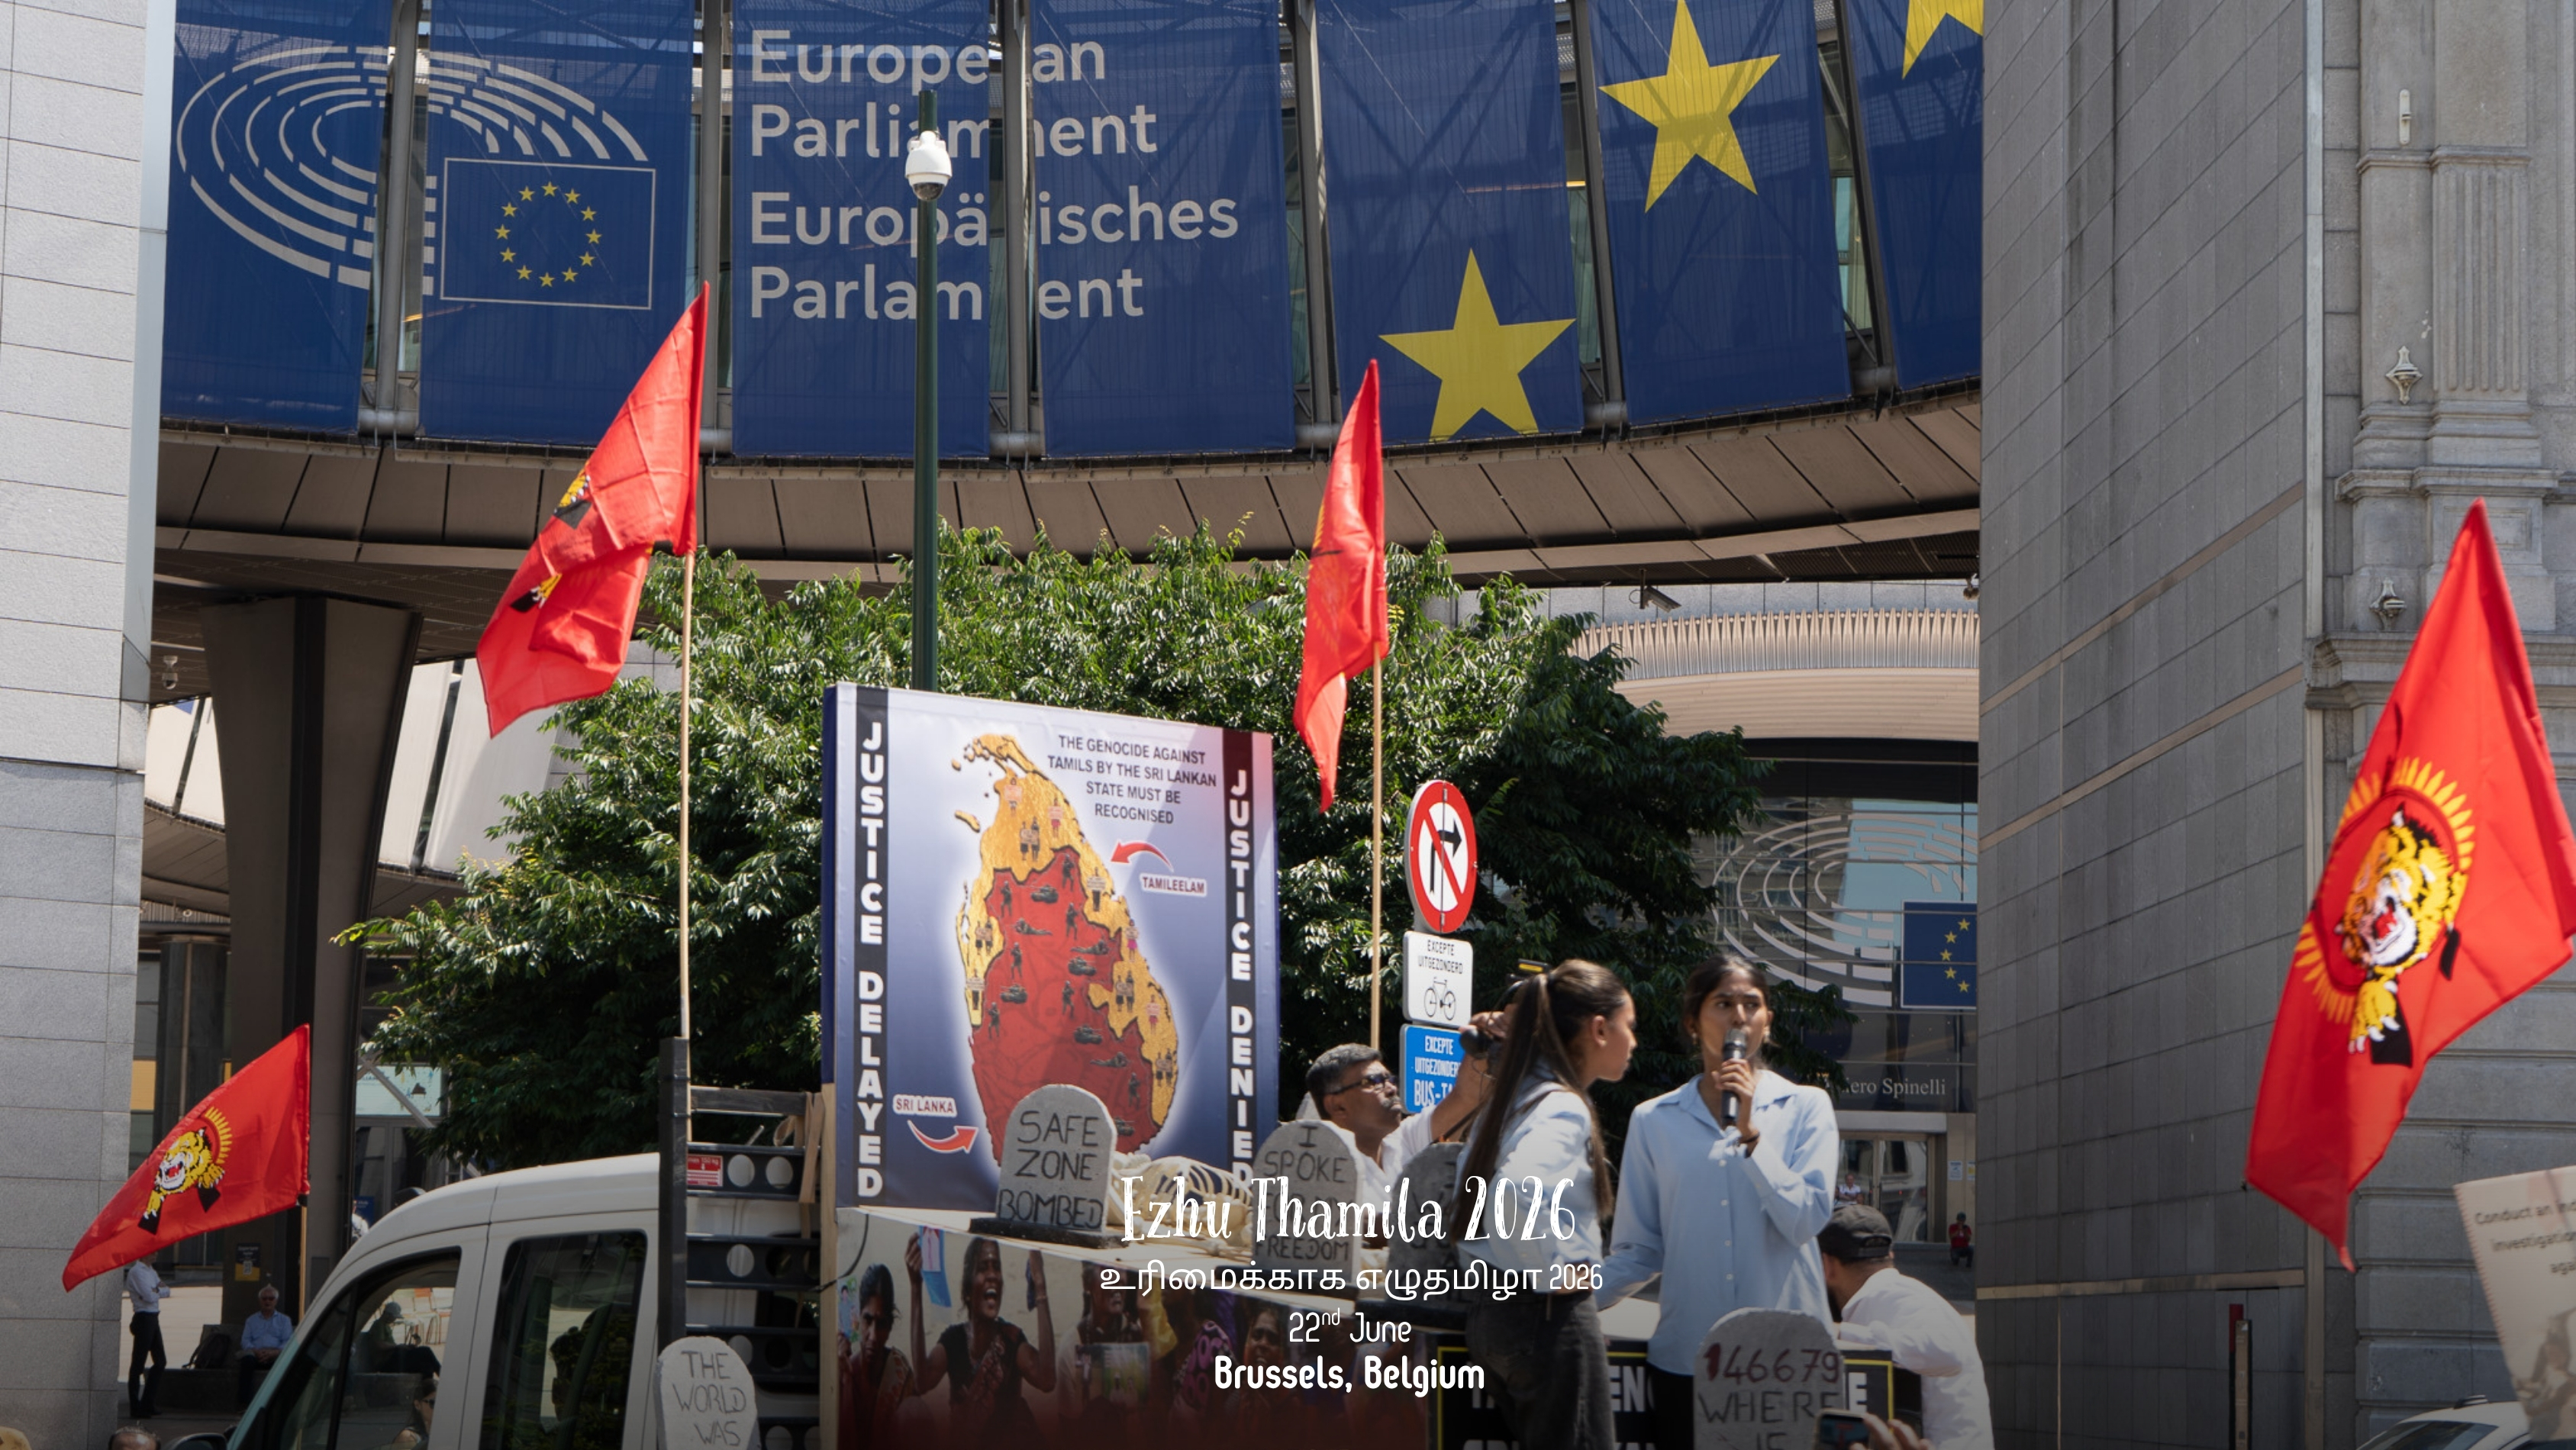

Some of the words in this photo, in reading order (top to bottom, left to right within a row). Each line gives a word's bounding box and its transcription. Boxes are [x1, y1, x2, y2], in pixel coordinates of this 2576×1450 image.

[751, 29, 1105, 96] European
[751, 102, 1158, 158] Parliment
[1059, 735, 1083, 750] THE
[1087, 738, 1149, 758] GENOCIDE
[1153, 746, 1205, 764] AGAINST
[1048, 755, 1092, 772] TAMILS
[1097, 761, 1112, 775] BY
[1117, 763, 1140, 778] THE
[1144, 767, 1164, 781] SRI
[1167, 769, 1217, 787] LANKAN
[1086, 781, 1124, 798] STATE
[1127, 785, 1161, 801] MUST
[1165, 790, 1181, 804] BE
[1095, 803, 1174, 824] RECOGNISED
[860, 722, 885, 945] JUSTICE
[1143, 876, 1204, 894] TAMILEELAM
[1230, 769, 1252, 981] JUSTICE
[1427, 939, 1455, 956] EXCEPTE
[1417, 955, 1463, 975] UITGEZONDERD
[1425, 1035, 1453, 1055] EXCEPTE
[1414, 1056, 1461, 1078] UITGEZONDER
[857, 971, 885, 1197] DELAYED
[1230, 1007, 1254, 1188] DENIED
[1882, 1078, 1946, 1099] Spinelli
[896, 1097, 914, 1111] SRI
[917, 1100, 954, 1113] LANKA
[1017, 1110, 1101, 1147] SAFE
[1298, 1125, 1319, 1148] I
[1014, 1148, 1098, 1181] ZONE
[1263, 1149, 1349, 1183] SPOKE
[998, 1187, 1104, 1229] BOMBED
[2475, 1207, 2533, 1224] Conduct
[681, 1349, 730, 1379] THE
[1704, 1343, 1841, 1385] 146679
[672, 1383, 746, 1414] WORLD
[694, 1420, 741, 1447] WAS
